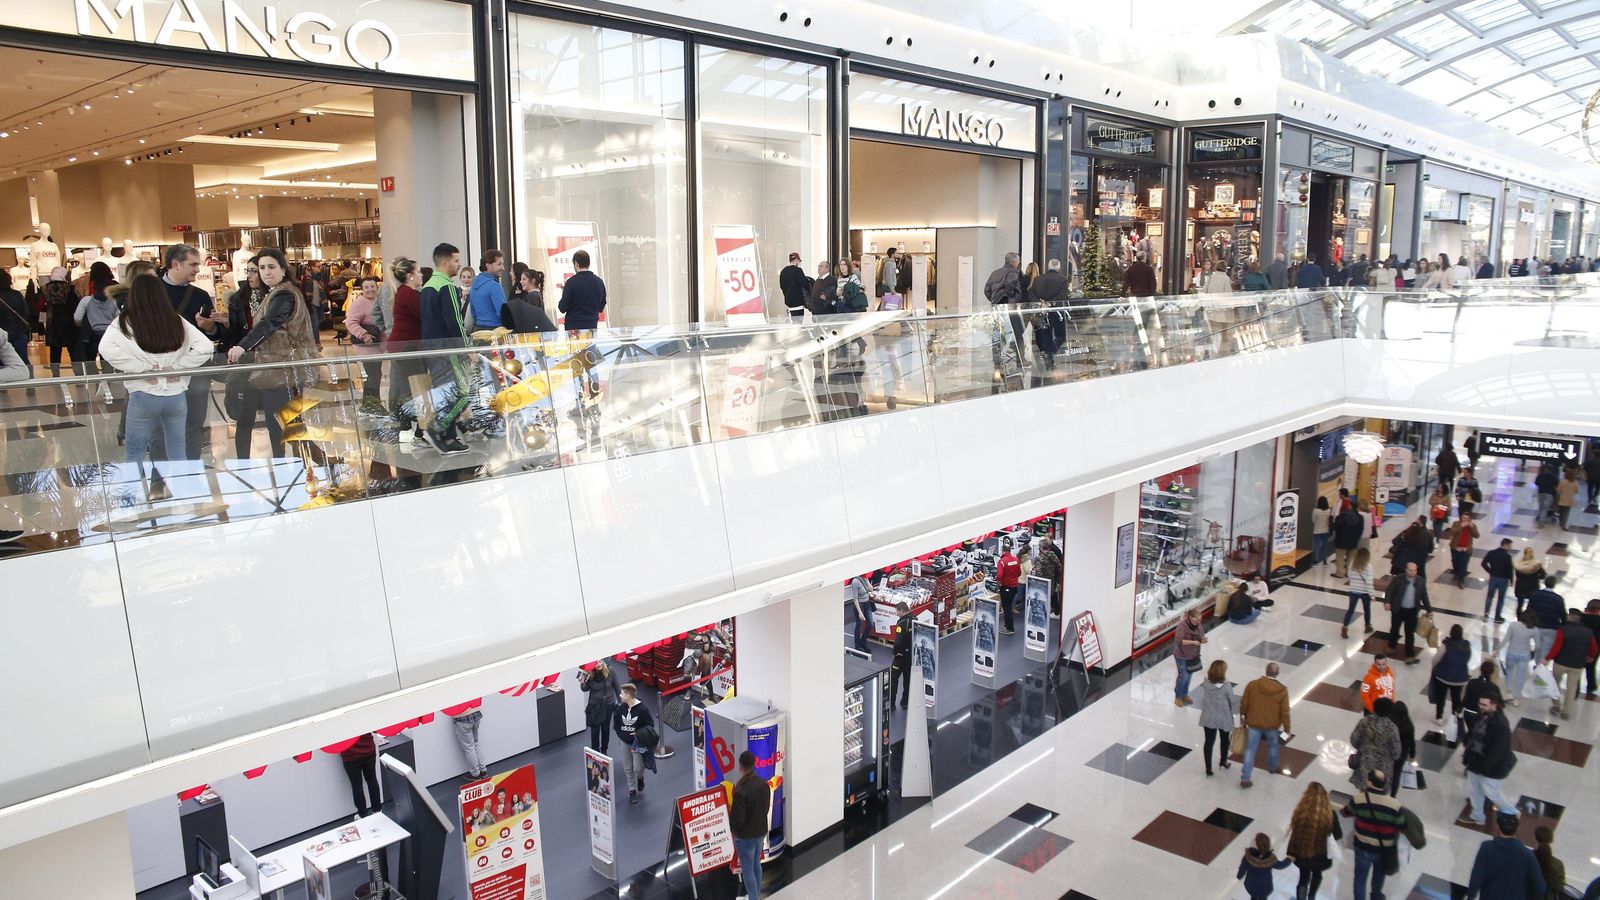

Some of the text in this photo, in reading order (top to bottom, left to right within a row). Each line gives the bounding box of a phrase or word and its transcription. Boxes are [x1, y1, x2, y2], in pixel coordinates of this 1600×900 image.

[74, 0, 400, 72] MANGO
[901, 101, 1006, 148] MANGO
[1099, 125, 1145, 144] GUTTERIDGE
[1194, 136, 1258, 149] GUTTERIDGE
[724, 269, 756, 292] -50
[1485, 436, 1565, 450] PLAZA CENTRAL
[1488, 446, 1560, 458] PLAZA GENERALIFE
[464, 788, 483, 801] CLUB
[682, 791, 721, 810] AHORRA EN TU
[691, 801, 716, 817] TARIFA
[688, 812, 725, 828] ESTUDIO GRATUITO
[691, 818, 724, 833] PERSONALIZADO
